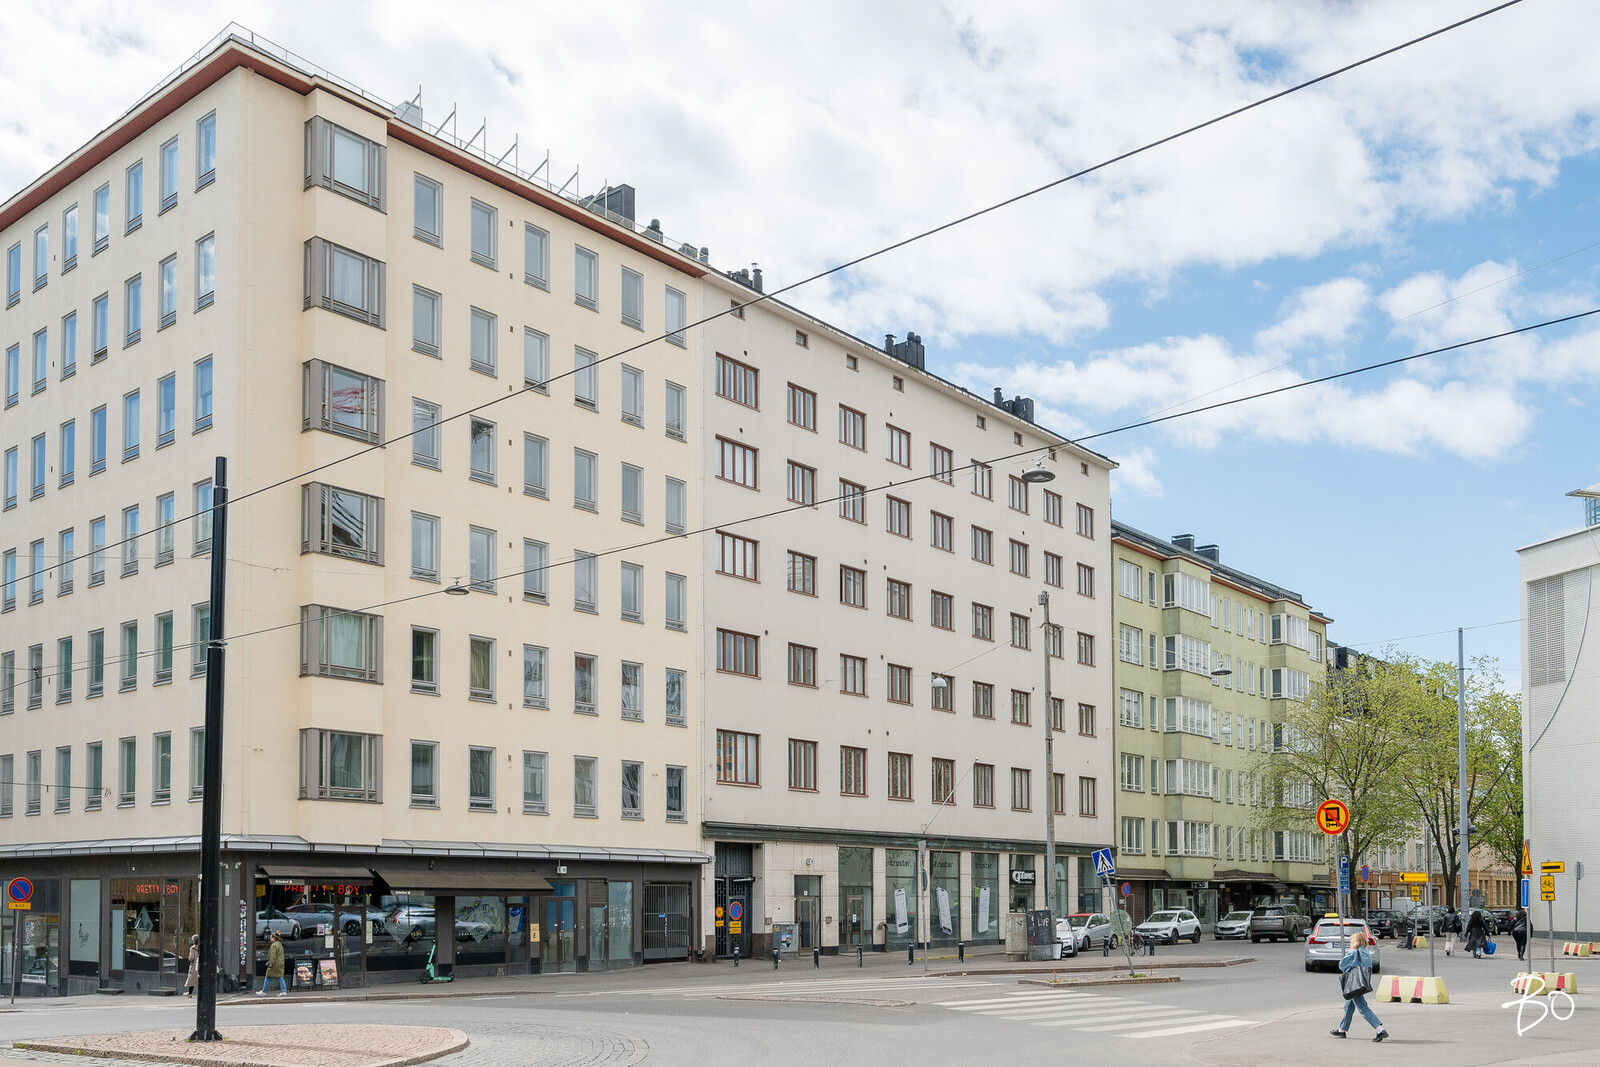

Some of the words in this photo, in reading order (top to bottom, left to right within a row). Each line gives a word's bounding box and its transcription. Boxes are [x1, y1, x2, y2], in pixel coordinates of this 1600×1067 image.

[889, 859, 911, 867] truster
[934, 860, 953, 868] truster
[975, 861, 993, 869] truster
[1340, 856, 1347, 867] P
[136, 884, 160, 894] PRETTY
[165, 884, 179, 894] BOY
[337, 884, 360, 895] BOY
